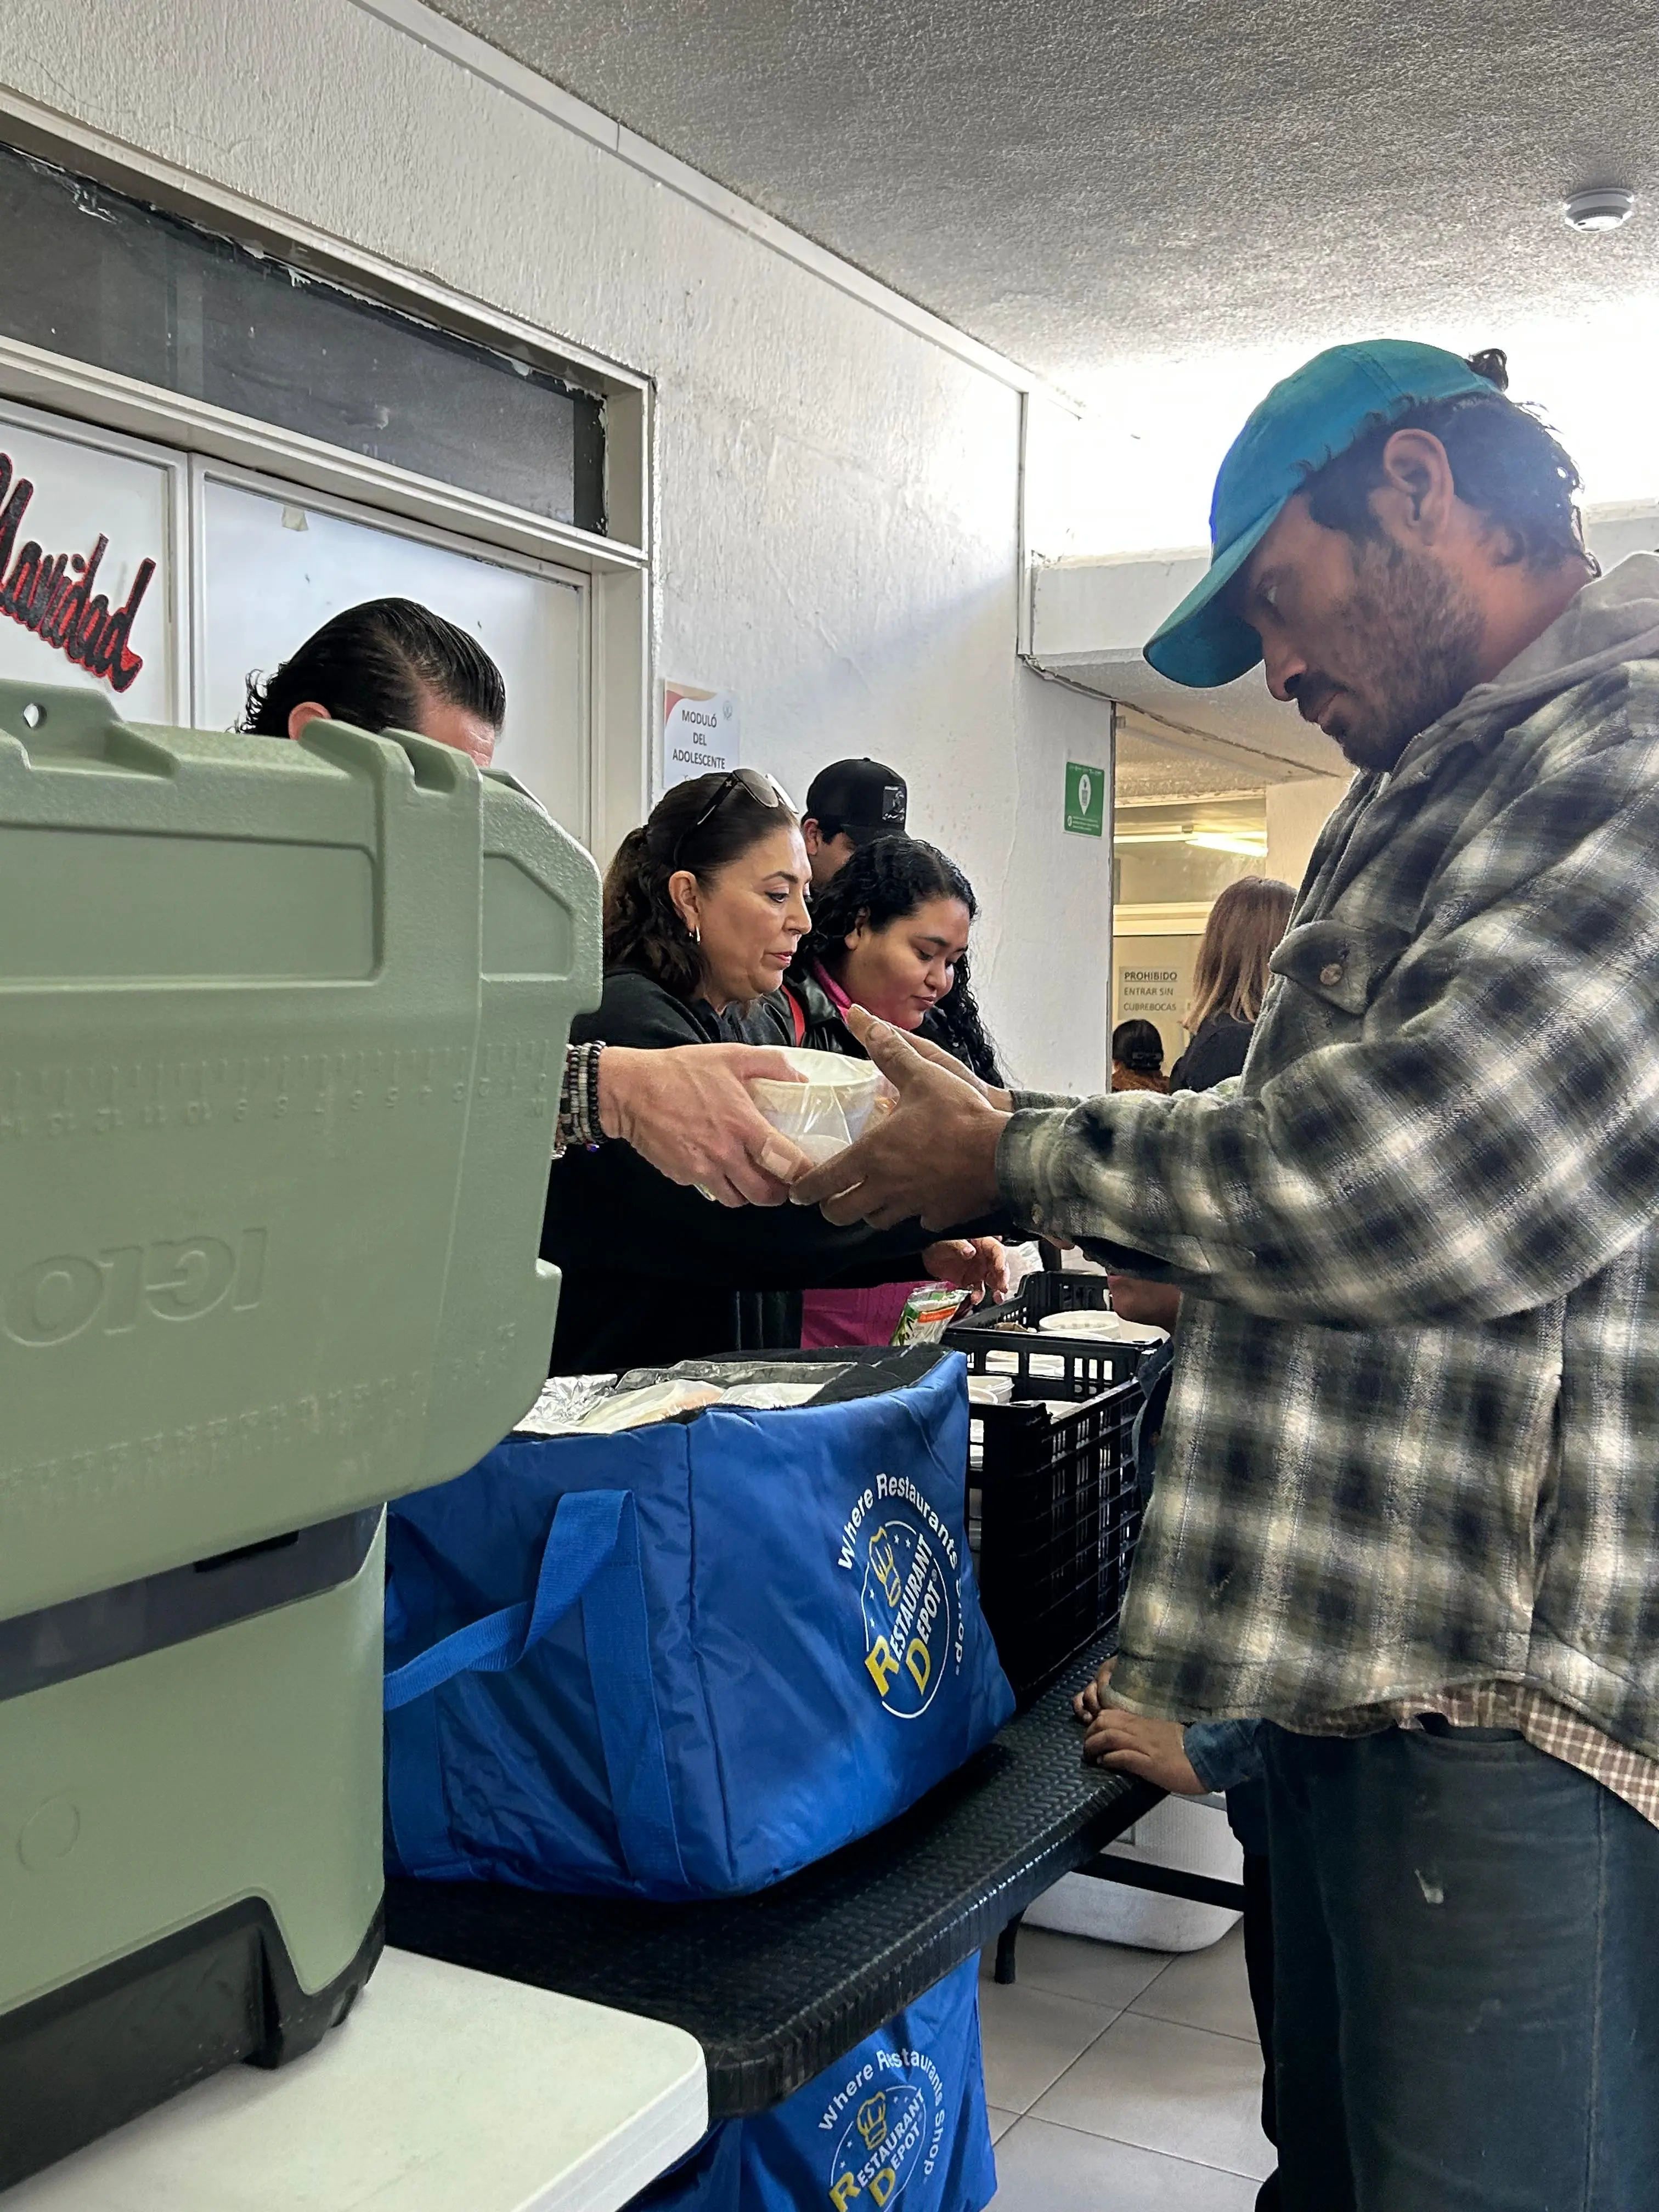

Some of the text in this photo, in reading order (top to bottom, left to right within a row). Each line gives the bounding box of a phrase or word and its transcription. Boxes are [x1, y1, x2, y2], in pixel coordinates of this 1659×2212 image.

[682, 709, 717, 728] MODULÓ
[693, 732, 707, 746] DEL
[673, 749, 725, 769] ADOLESCENTE
[1124, 972, 1177, 980] PROHIBIDO
[1124, 987, 1173, 996] ENTRAR SIN
[1124, 1003, 1177, 1011] CUBREBOCAS
[838, 1473, 964, 1675] Where Restaurants Sop.
[865, 1532, 933, 1697] RESTAURANT
[818, 2063, 874, 2130] Where
[829, 2087, 924, 2212] RESTAURANT
